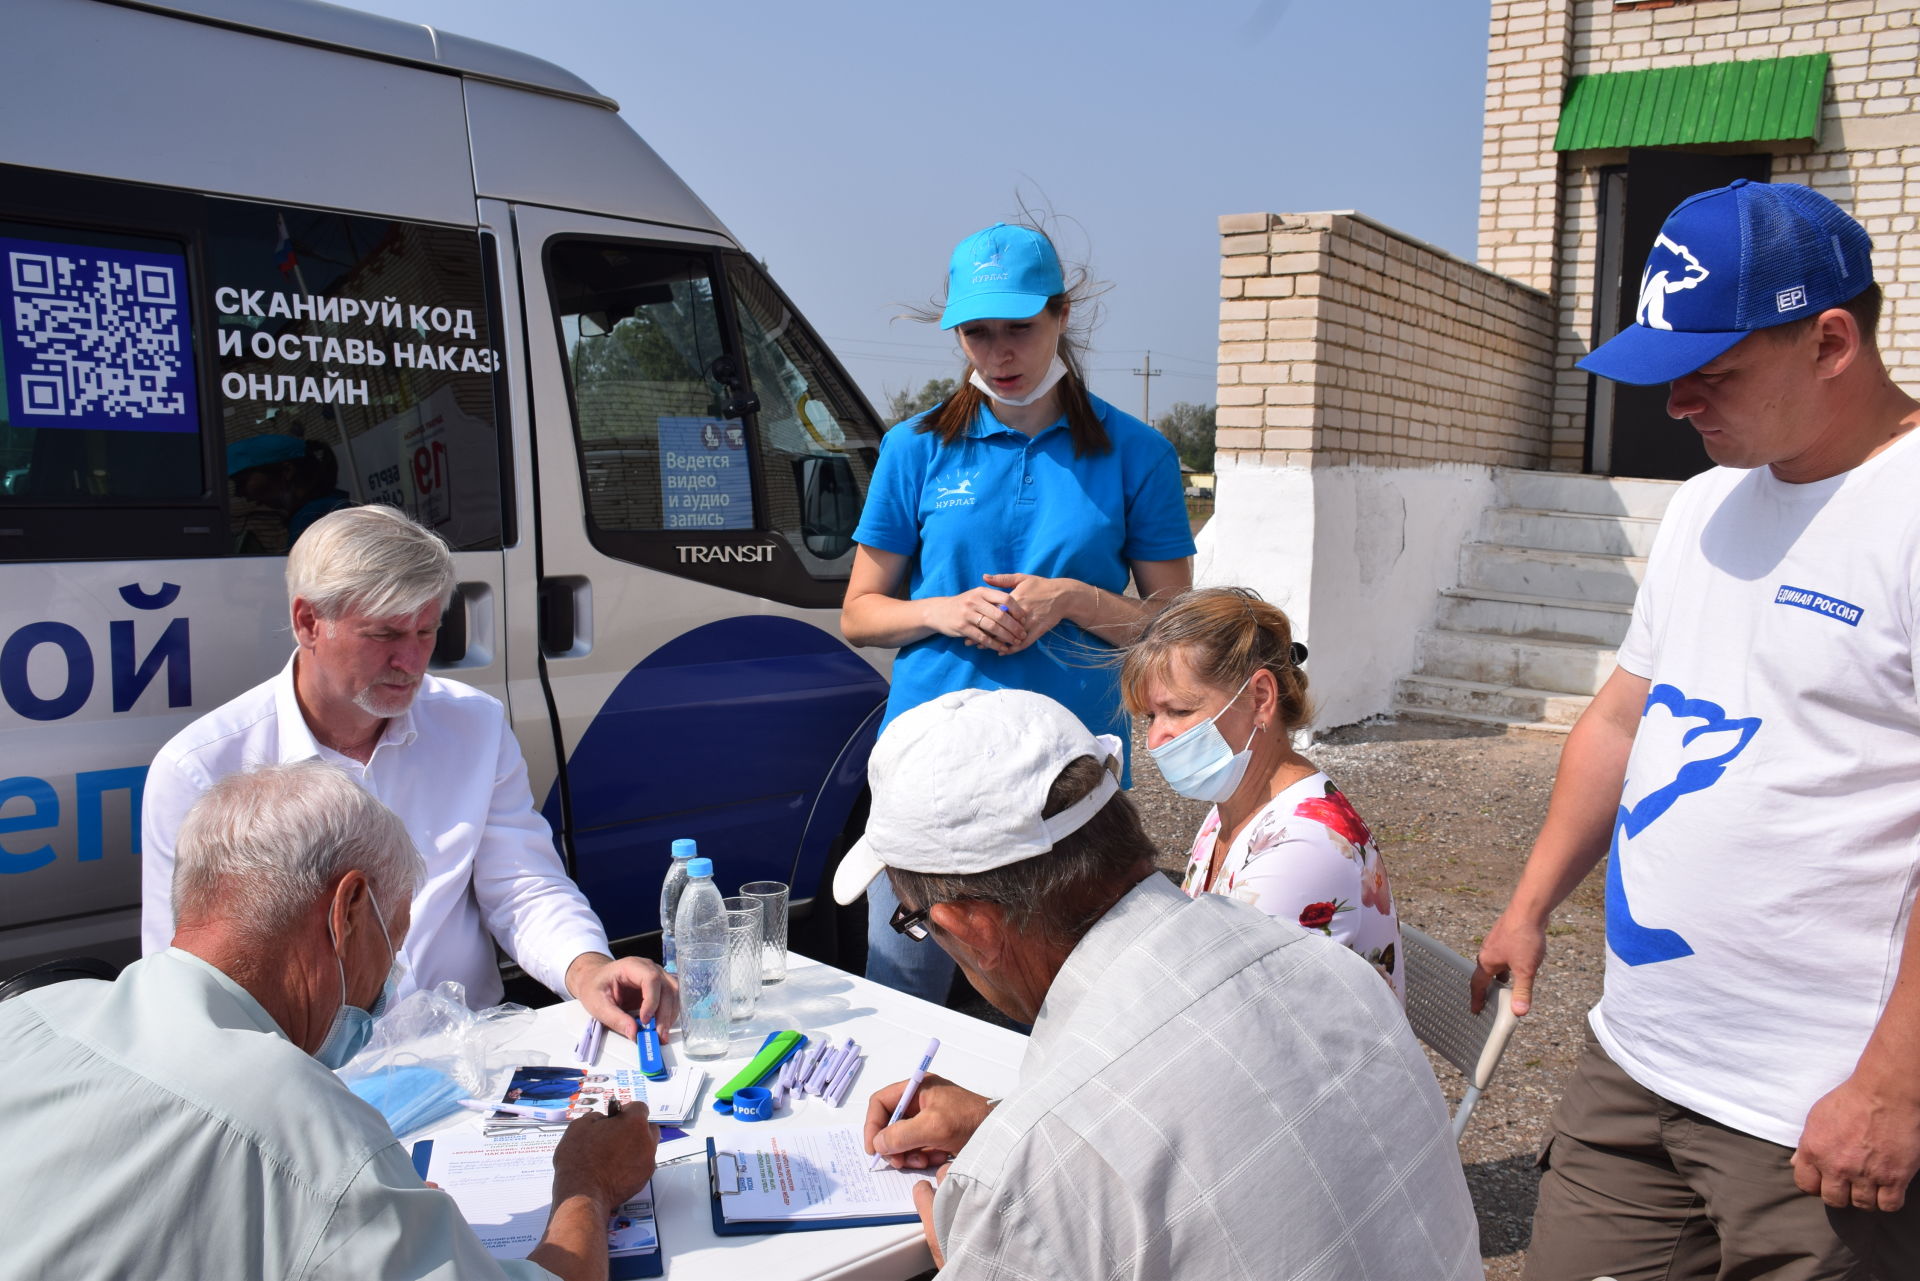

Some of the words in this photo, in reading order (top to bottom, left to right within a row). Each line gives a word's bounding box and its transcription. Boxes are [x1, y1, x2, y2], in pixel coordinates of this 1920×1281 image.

[972, 273, 1009, 284] НУРЛАТ
[215, 286, 403, 329] СКАНИРУЙ
[409, 304, 477, 340] КОД
[218, 328, 243, 357] И
[251, 331, 387, 366] ОСТАВЬ
[393, 342, 500, 373] НАКАЗ
[221, 371, 369, 405] ОНЛАЙН
[666, 452, 730, 471] Ведется
[668, 475, 717, 491] видео
[668, 495, 679, 508] и
[683, 493, 730, 511] аудио
[936, 497, 976, 509] НУРЛАТ
[670, 513, 725, 528] запись
[675, 545, 776, 563] TRANSIT
[1777, 588, 1814, 606] ЕДИНАЯ
[1812, 596, 1859, 622] РОССИЯ
